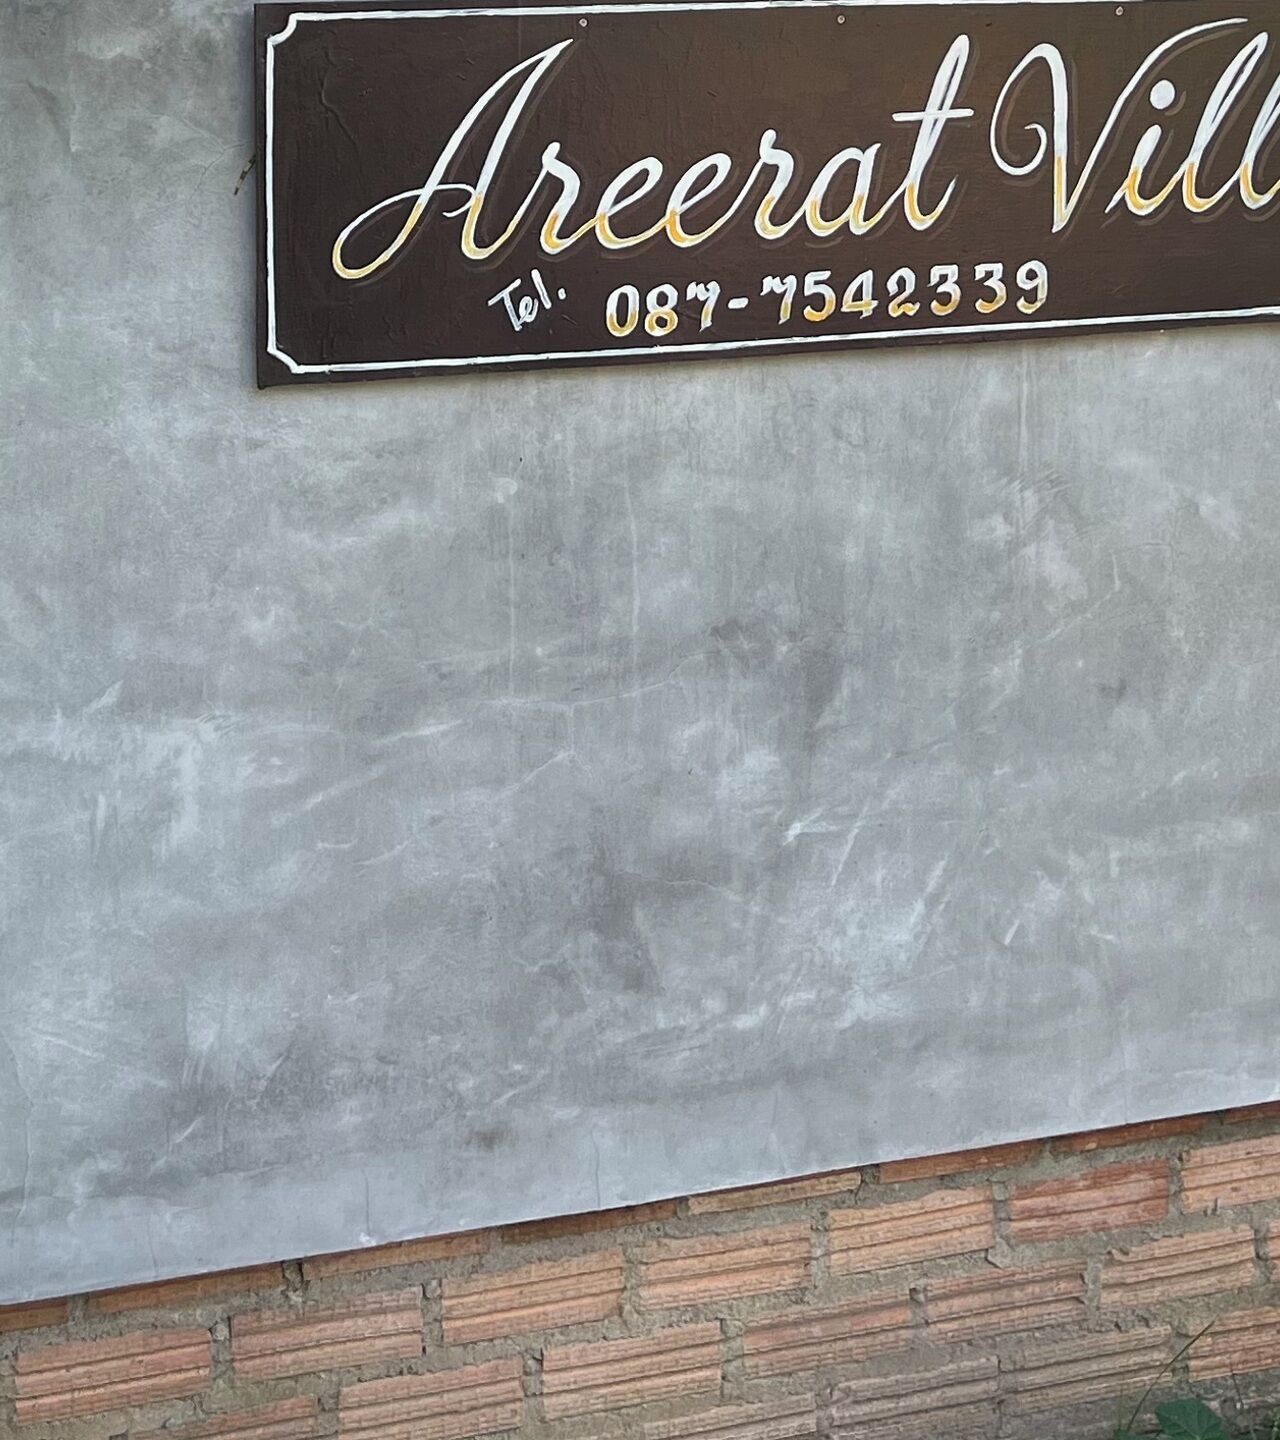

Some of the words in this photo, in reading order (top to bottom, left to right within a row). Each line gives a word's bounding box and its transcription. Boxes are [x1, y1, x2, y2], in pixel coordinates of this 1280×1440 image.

[331, 33, 976, 281] Areerat
[486, 268, 569, 334] Tel.
[604, 258, 1051, 339] 087-7542339
